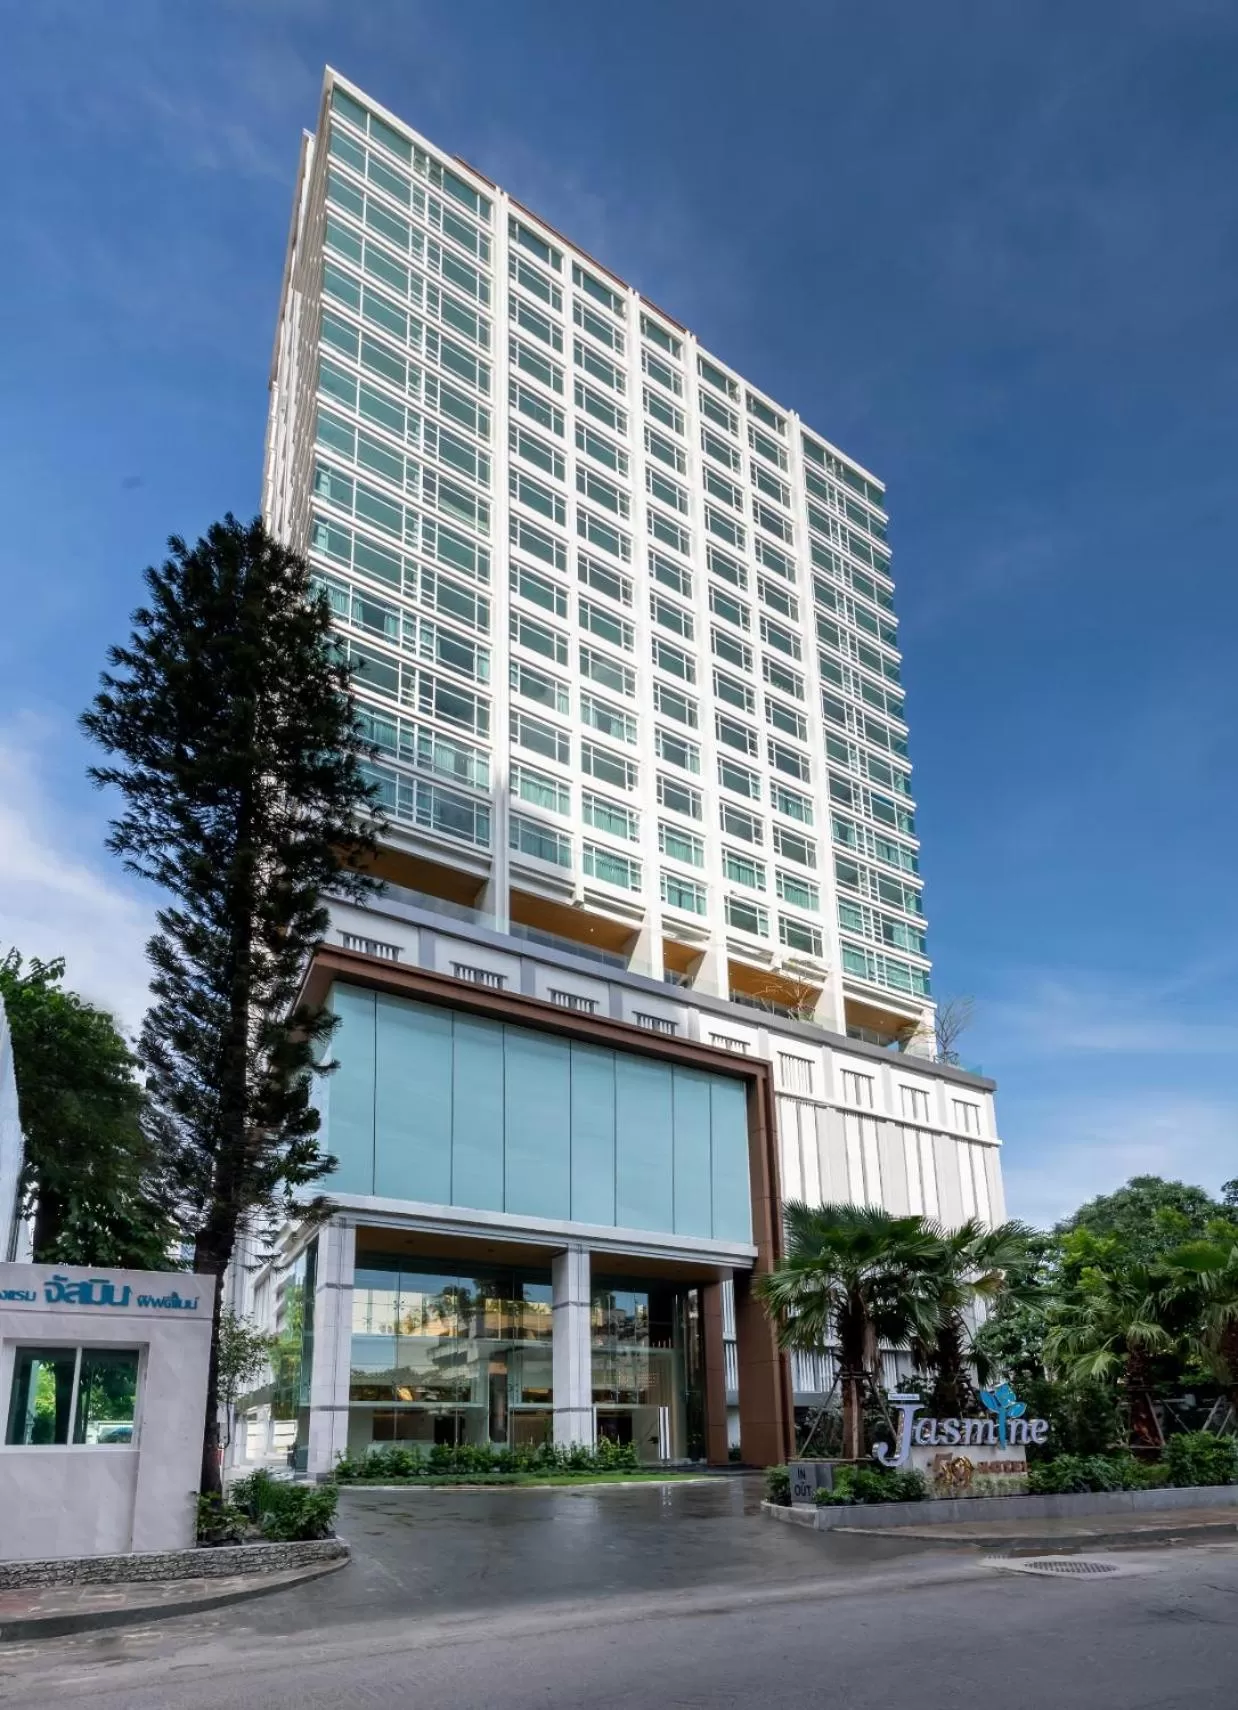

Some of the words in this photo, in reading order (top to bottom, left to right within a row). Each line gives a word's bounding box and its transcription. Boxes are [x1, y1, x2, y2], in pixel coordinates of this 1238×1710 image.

[44, 1274, 133, 1307] จัสมิน
[872, 1401, 1050, 1467] Jasmine
[797, 1466, 806, 1481] IN
[794, 1484, 812, 1497] OUT
